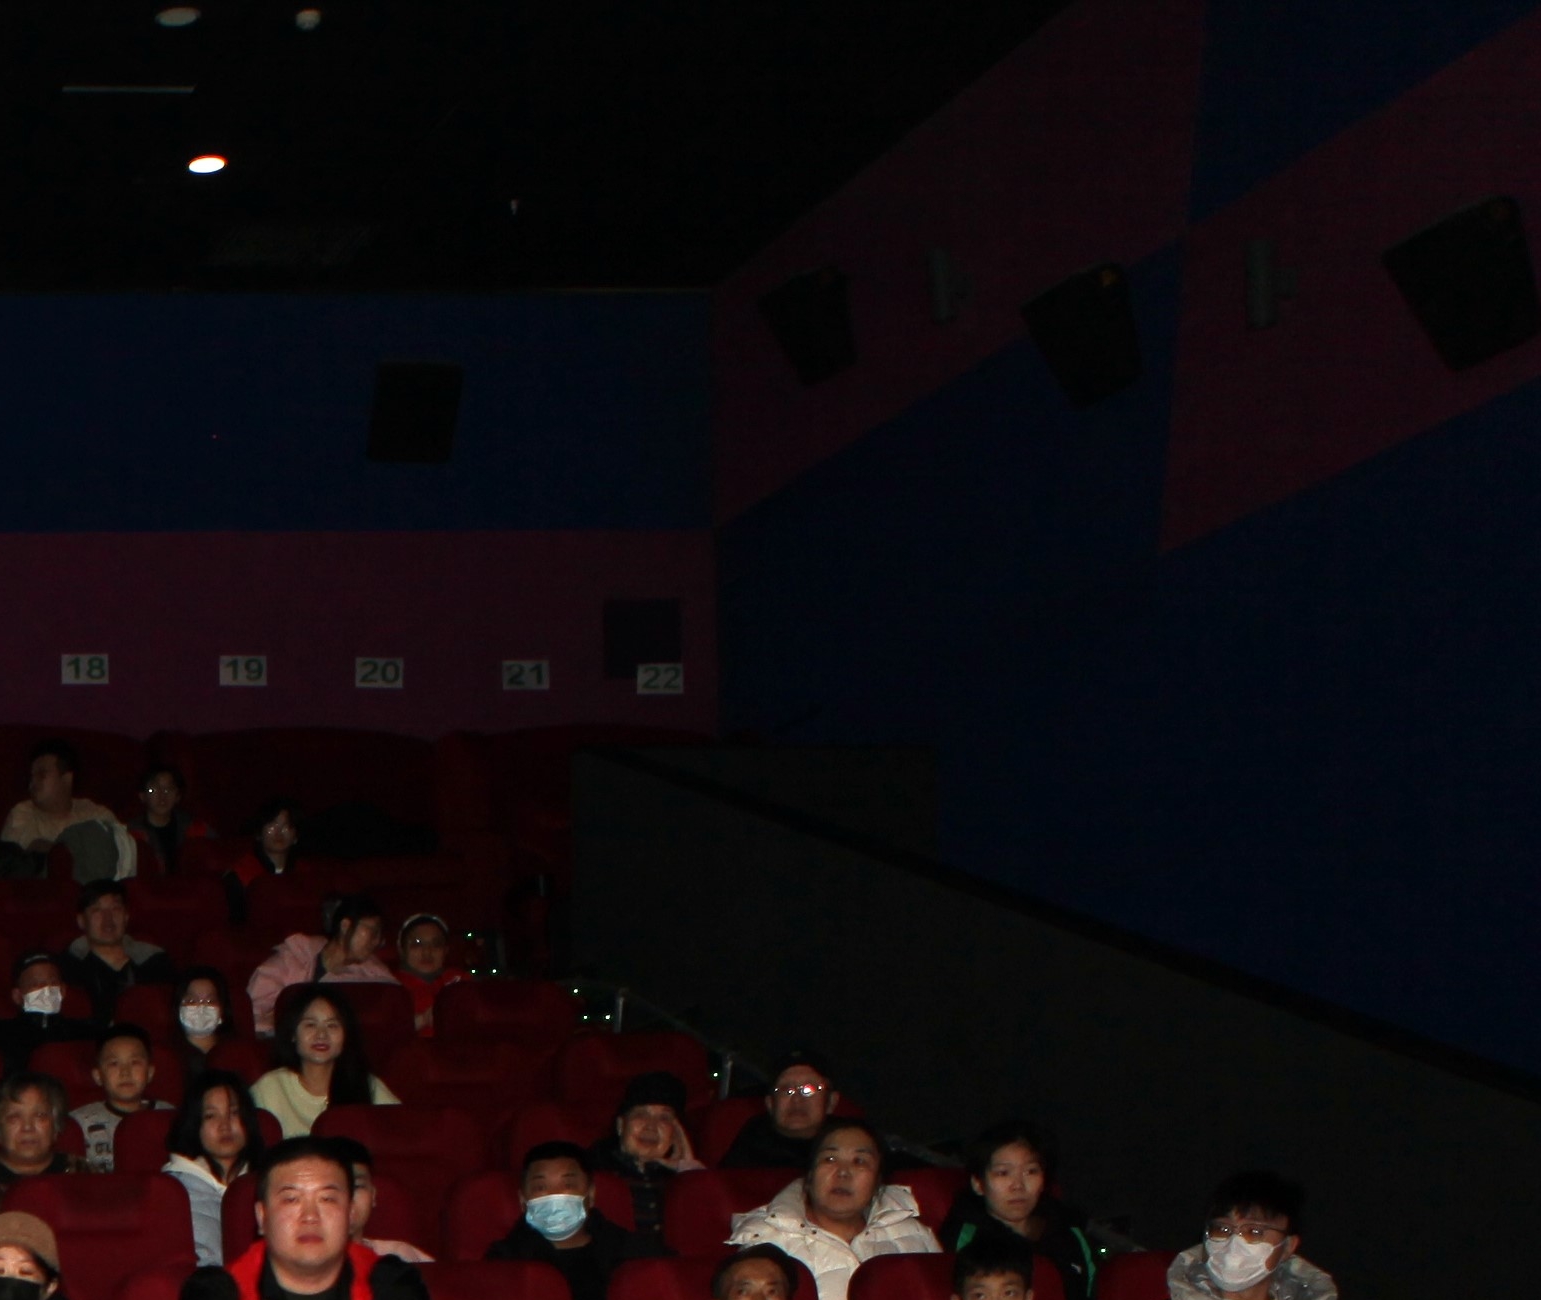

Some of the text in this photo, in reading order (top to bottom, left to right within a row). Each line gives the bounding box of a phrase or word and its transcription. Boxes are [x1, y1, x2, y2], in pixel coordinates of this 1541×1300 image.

[67, 657, 106, 680] 18
[225, 659, 264, 682] 19
[359, 661, 400, 684] 20
[506, 664, 543, 685] 21
[641, 667, 681, 690] 22
